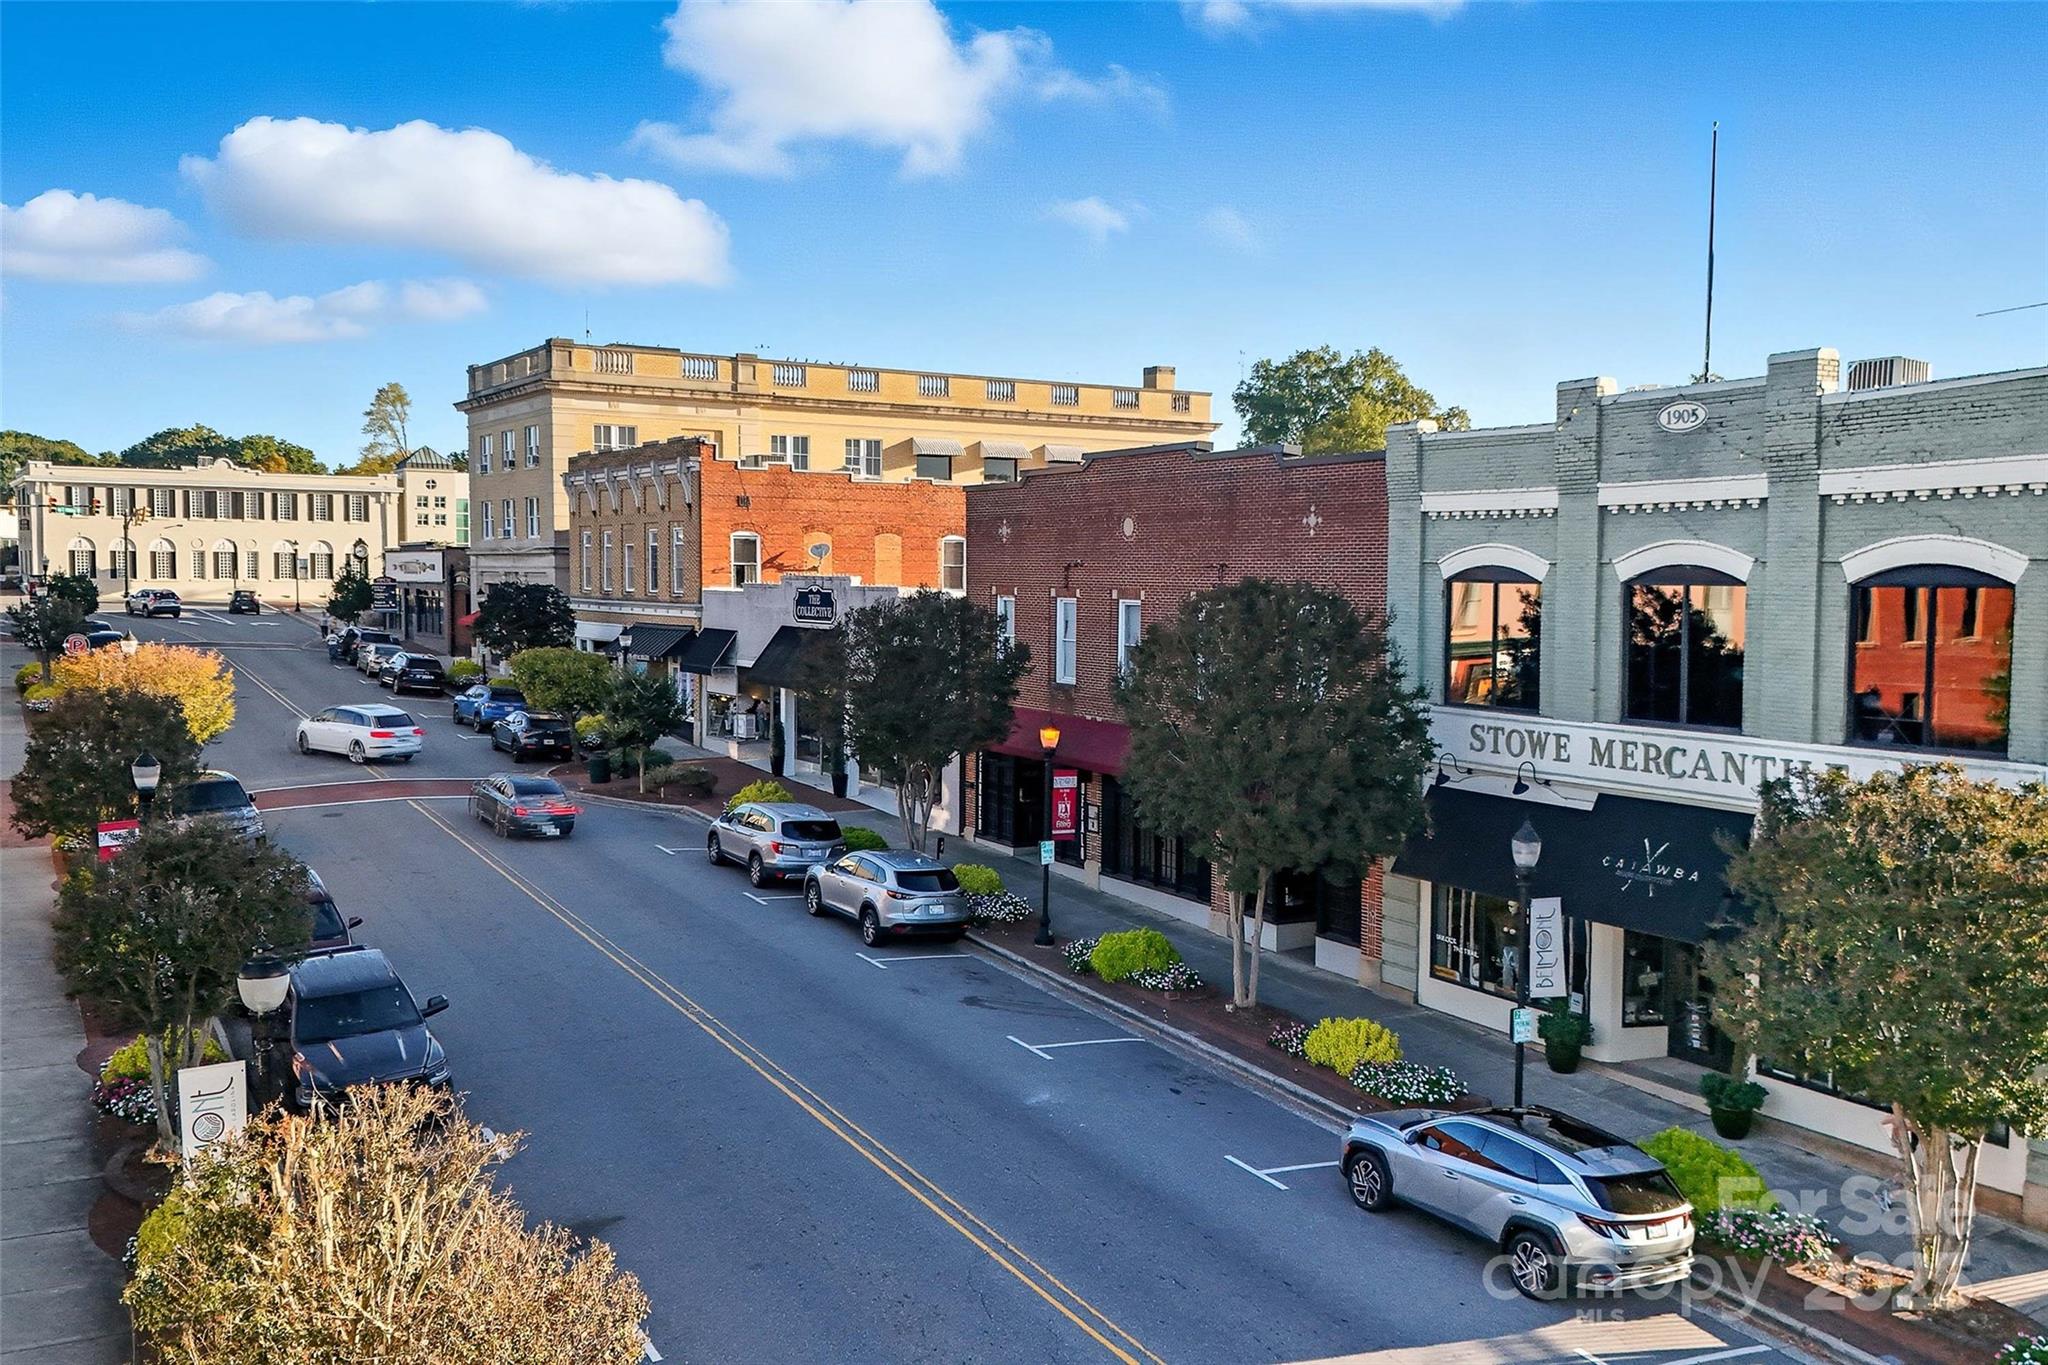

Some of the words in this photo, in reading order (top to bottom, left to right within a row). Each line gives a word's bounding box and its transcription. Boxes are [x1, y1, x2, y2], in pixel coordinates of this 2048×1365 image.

[1666, 408, 1700, 425] 1905
[808, 594, 821, 605] THE
[797, 606, 832, 618] COLLECTIVE
[1469, 724, 1571, 763] STOWE
